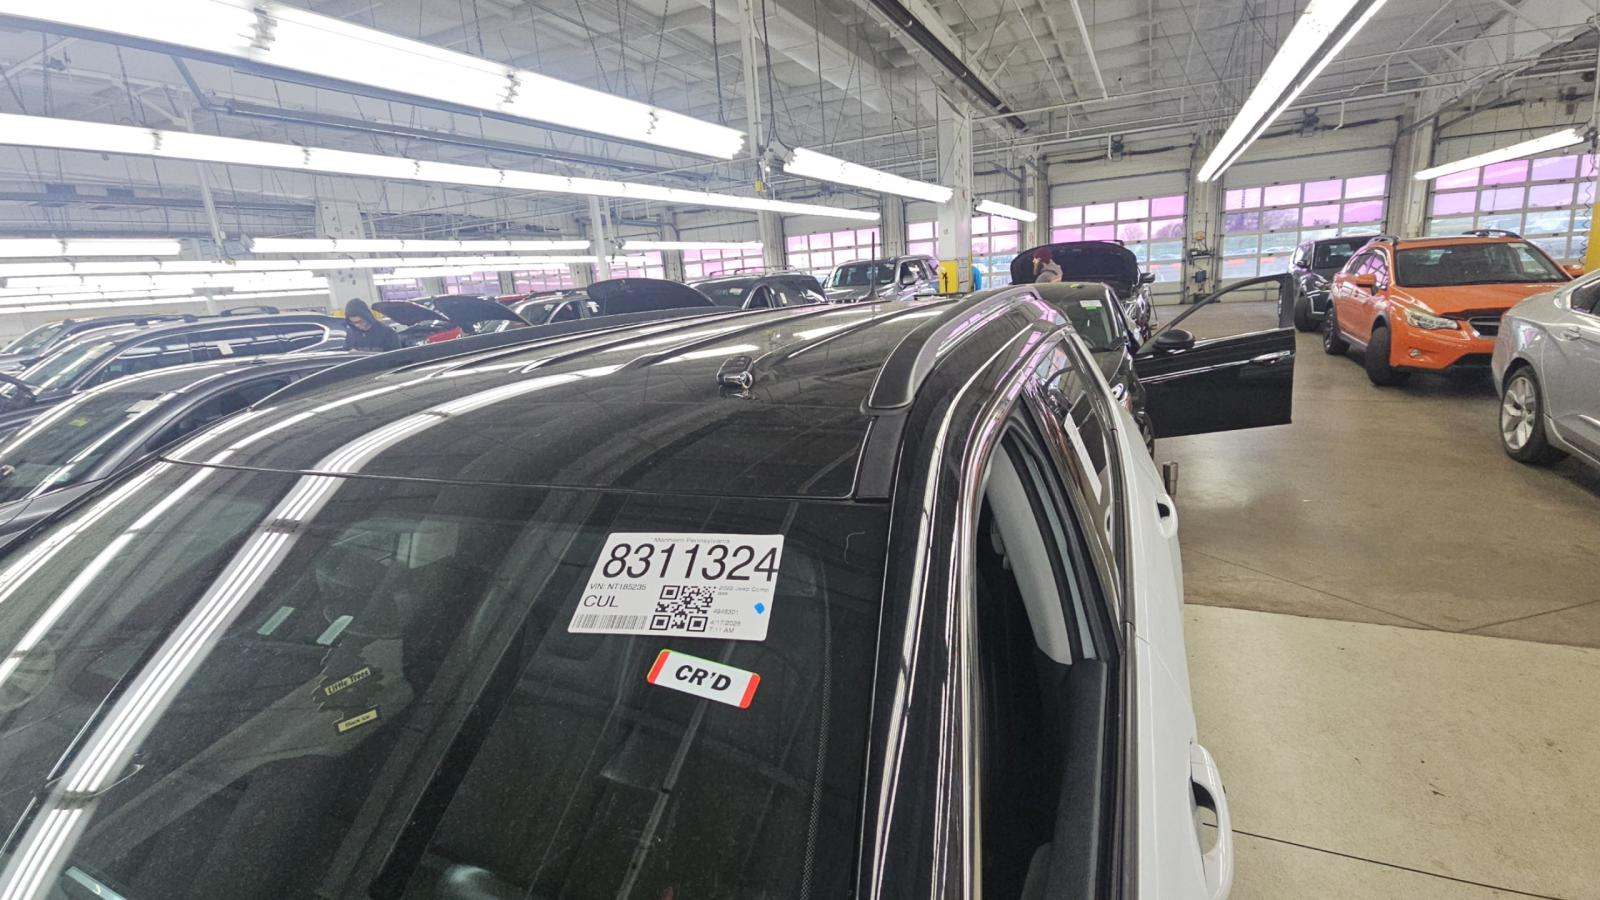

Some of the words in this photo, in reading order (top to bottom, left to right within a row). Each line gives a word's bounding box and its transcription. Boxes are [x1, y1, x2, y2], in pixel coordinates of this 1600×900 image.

[602, 543, 778, 581] 8311324
[583, 594, 619, 608] CUL
[675, 664, 732, 691] CR'D
